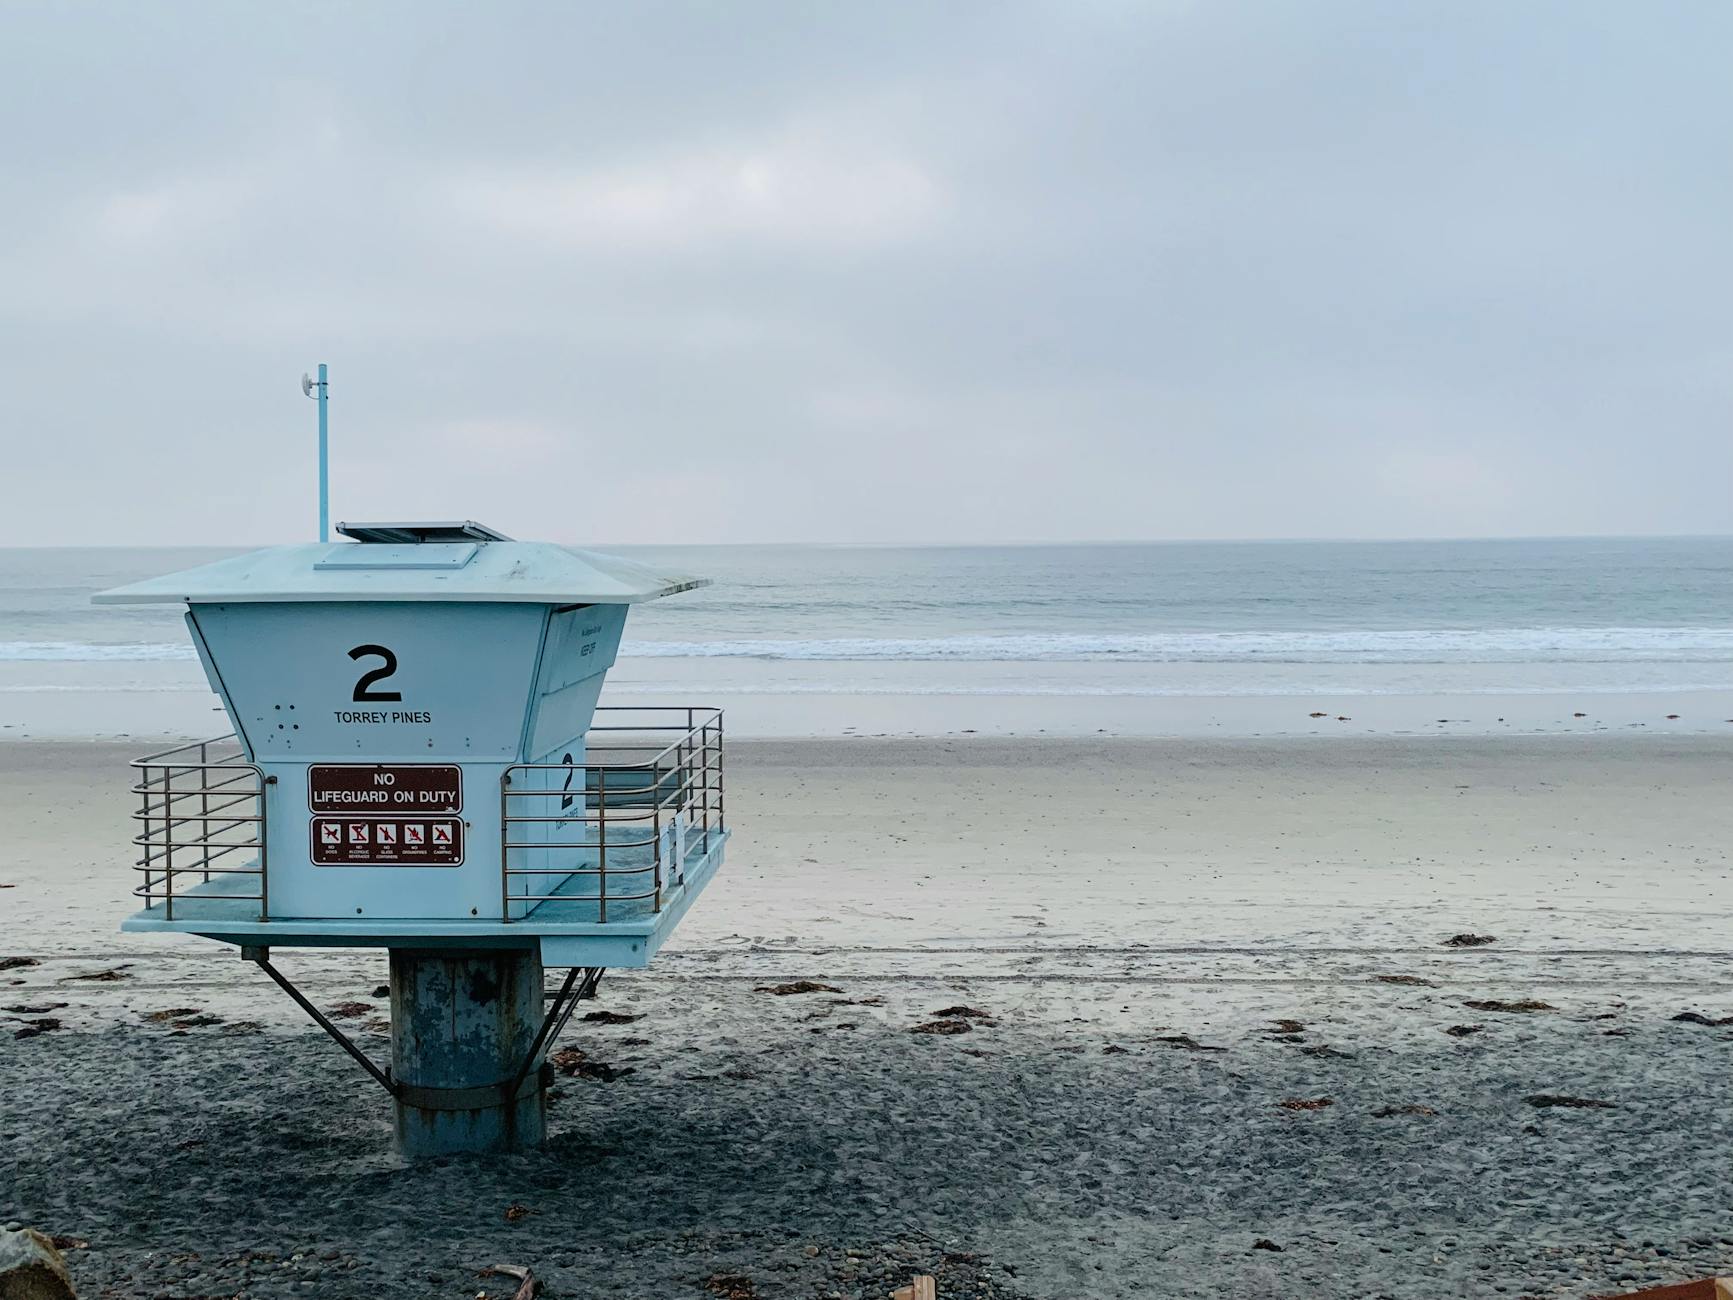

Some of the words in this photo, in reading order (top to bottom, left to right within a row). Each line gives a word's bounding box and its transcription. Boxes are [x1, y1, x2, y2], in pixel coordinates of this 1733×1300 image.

[347, 644, 402, 702] 2
[334, 711, 388, 724] TORREY
[392, 711, 431, 724] PINES
[373, 773, 395, 786] NO
[561, 752, 573, 810] 2
[313, 790, 389, 803] LIFEGUARD
[393, 790, 414, 803] ON
[419, 790, 456, 803] DUTY
